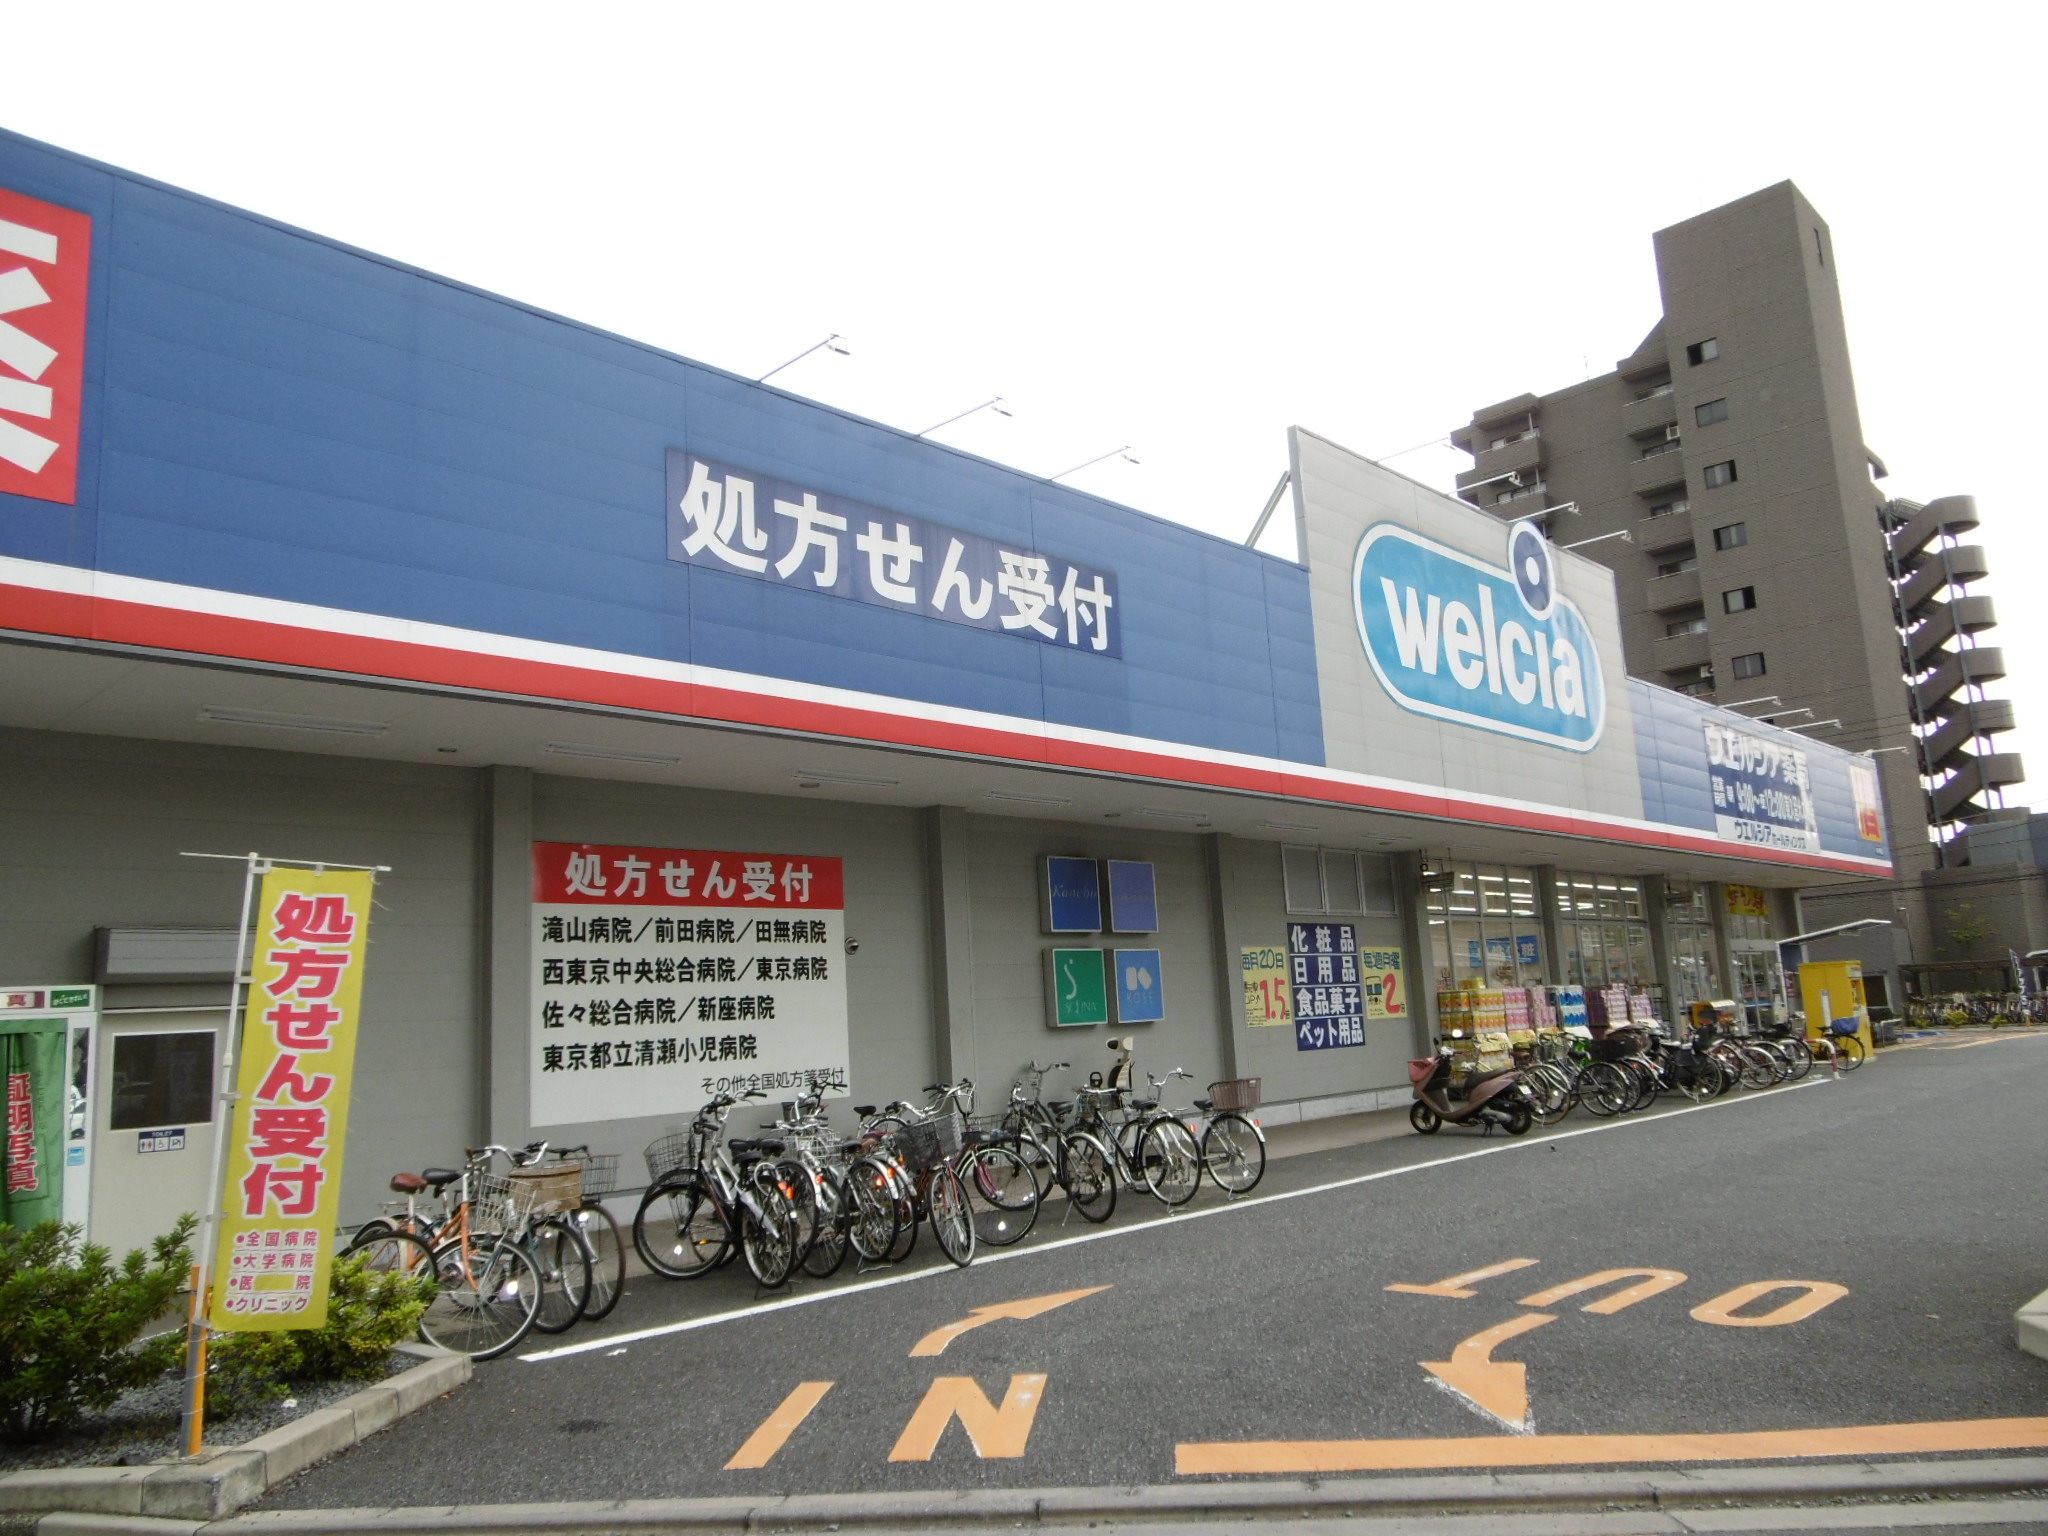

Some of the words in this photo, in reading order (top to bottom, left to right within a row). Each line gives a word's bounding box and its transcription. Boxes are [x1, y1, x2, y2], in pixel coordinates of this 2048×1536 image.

[679, 460, 1113, 652] 処方せん受付
[1380, 576, 1587, 718] welcia
[564, 852, 814, 903] 処方せん受付
[1291, 924, 1354, 953] 化粧品
[1294, 955, 1356, 983] 日用品
[1296, 986, 1360, 1016] 食品菓子
[1299, 1016, 1364, 1048] ペット用品
[243, 893, 355, 1216] 処方せん受付
[542, 1033, 758, 1073] 東京都立清瀬小児病院
[7, 1072, 38, 1194] 証明写真
[246, 1231, 318, 1247] 全国病院
[243, 1253, 315, 1269] 大学病院
[235, 1297, 309, 1312] クリニック
[1383, 1257, 1850, 1327] OUT
[723, 1372, 1048, 1470] IN
